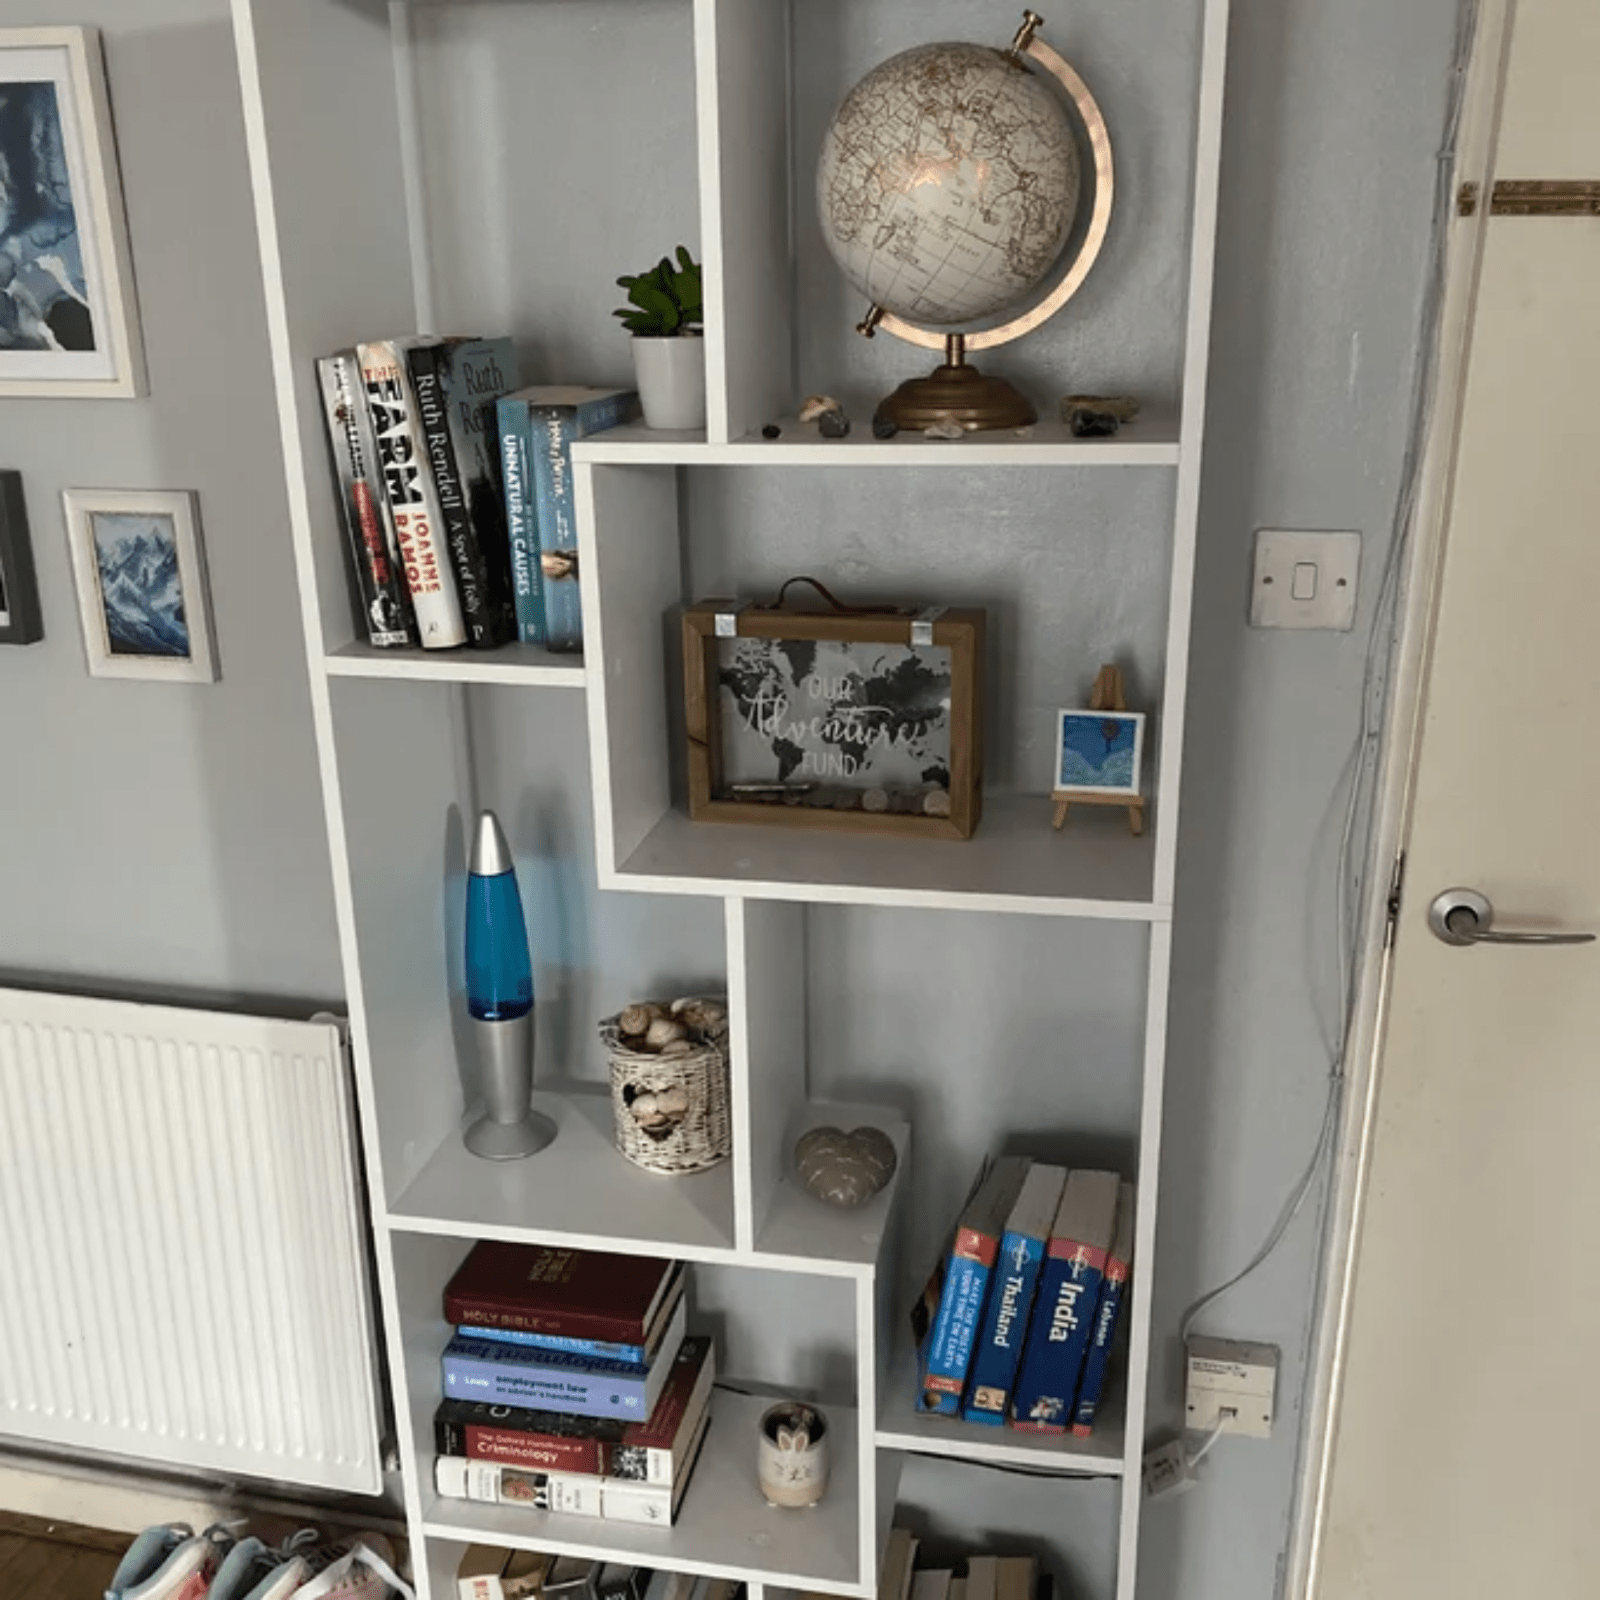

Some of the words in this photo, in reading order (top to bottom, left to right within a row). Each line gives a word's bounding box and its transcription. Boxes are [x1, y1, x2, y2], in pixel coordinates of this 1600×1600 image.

[416, 374, 443, 426] Ruth
[366, 378, 423, 504] FARM
[428, 432, 462, 509] Rendell
[449, 521, 462, 532] A
[503, 434, 525, 536] UNNATURAL
[514, 538, 531, 596] CAUSES
[395, 513, 422, 593] RAMOS
[413, 512, 441, 593] JOANNE
[452, 533, 469, 564] Spot
[808, 675, 852, 699] OUR
[741, 688, 920, 746] Adventure
[801, 751, 857, 777] FUND
[463, 1310, 498, 1324] HOLY
[501, 1314, 540, 1328] BIBLE
[993, 1276, 1024, 1348] Thailand
[1049, 1281, 1085, 1342] India
[495, 1376, 565, 1392] employment
[567, 1381, 588, 1394] law
[476, 1441, 558, 1464] Criminology
[477, 1432, 494, 1443] The
[496, 1435, 526, 1446] Oxford
[527, 1438, 571, 1451] Handbook
